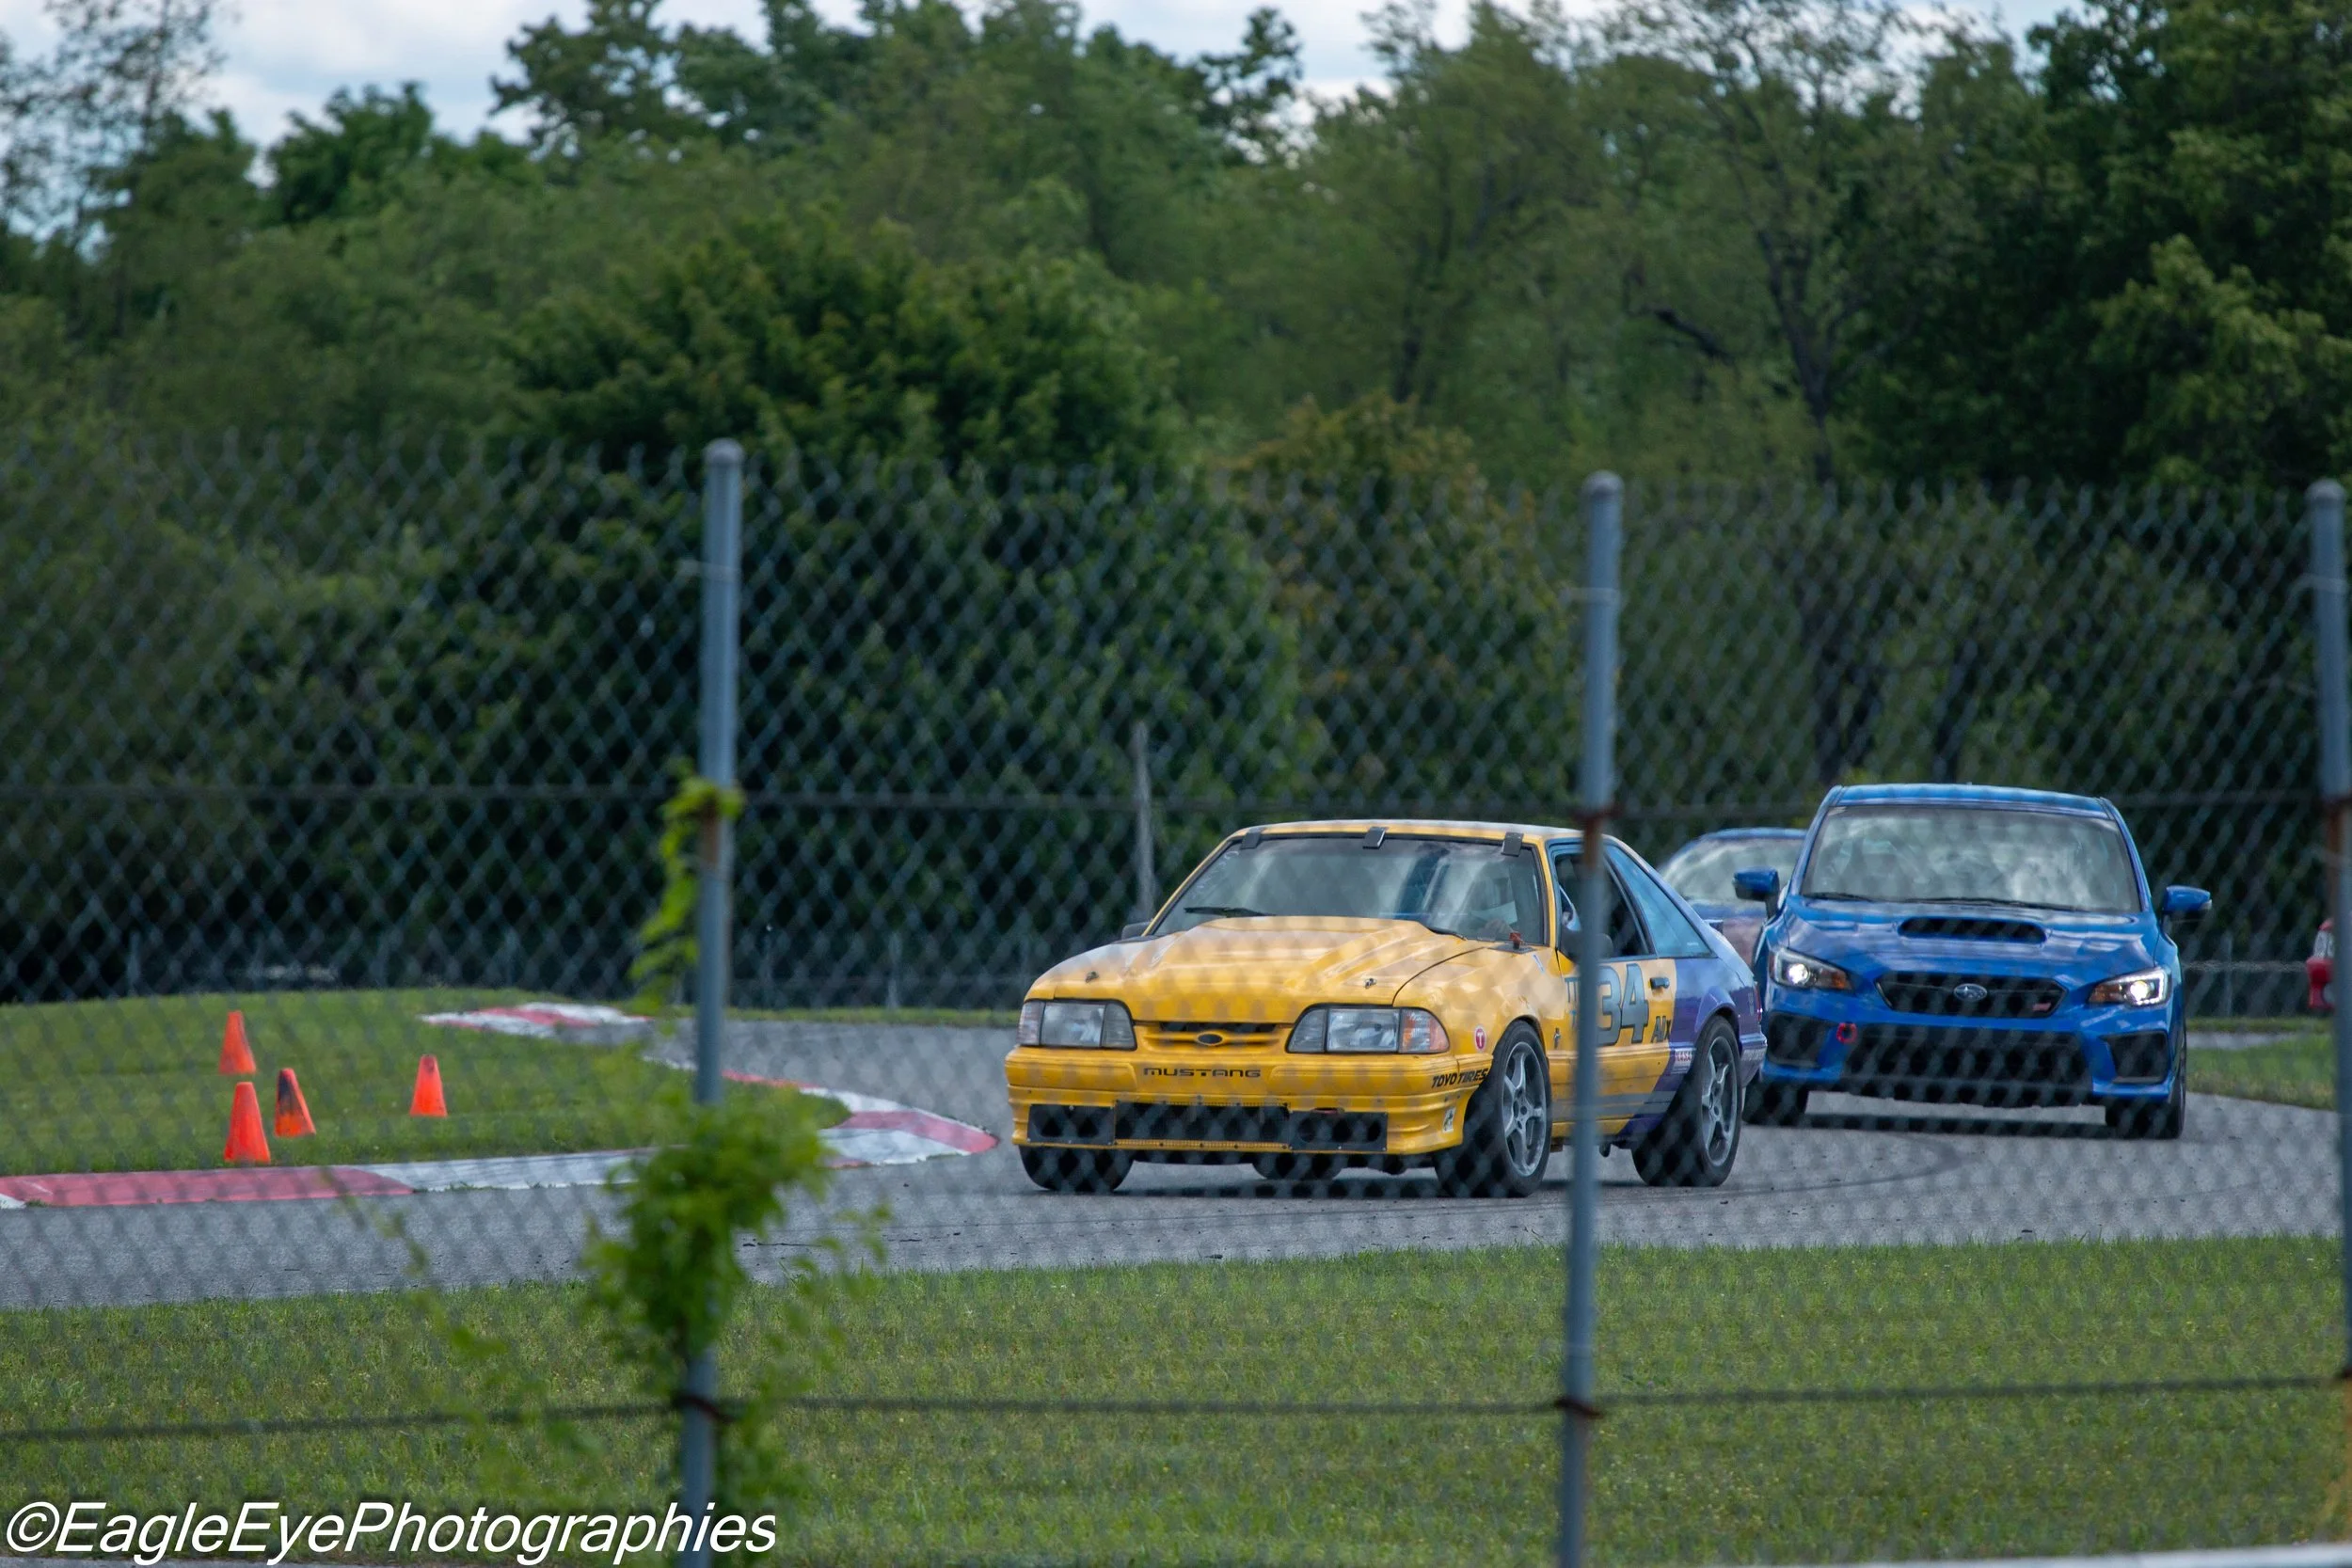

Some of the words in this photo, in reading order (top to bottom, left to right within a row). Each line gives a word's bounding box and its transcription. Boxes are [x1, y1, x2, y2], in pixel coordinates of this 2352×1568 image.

[1143, 1068, 1262, 1078] MUSTANG
[1432, 1072, 1457, 1088] TOYO
[1457, 1068, 1489, 1085] TIRES
